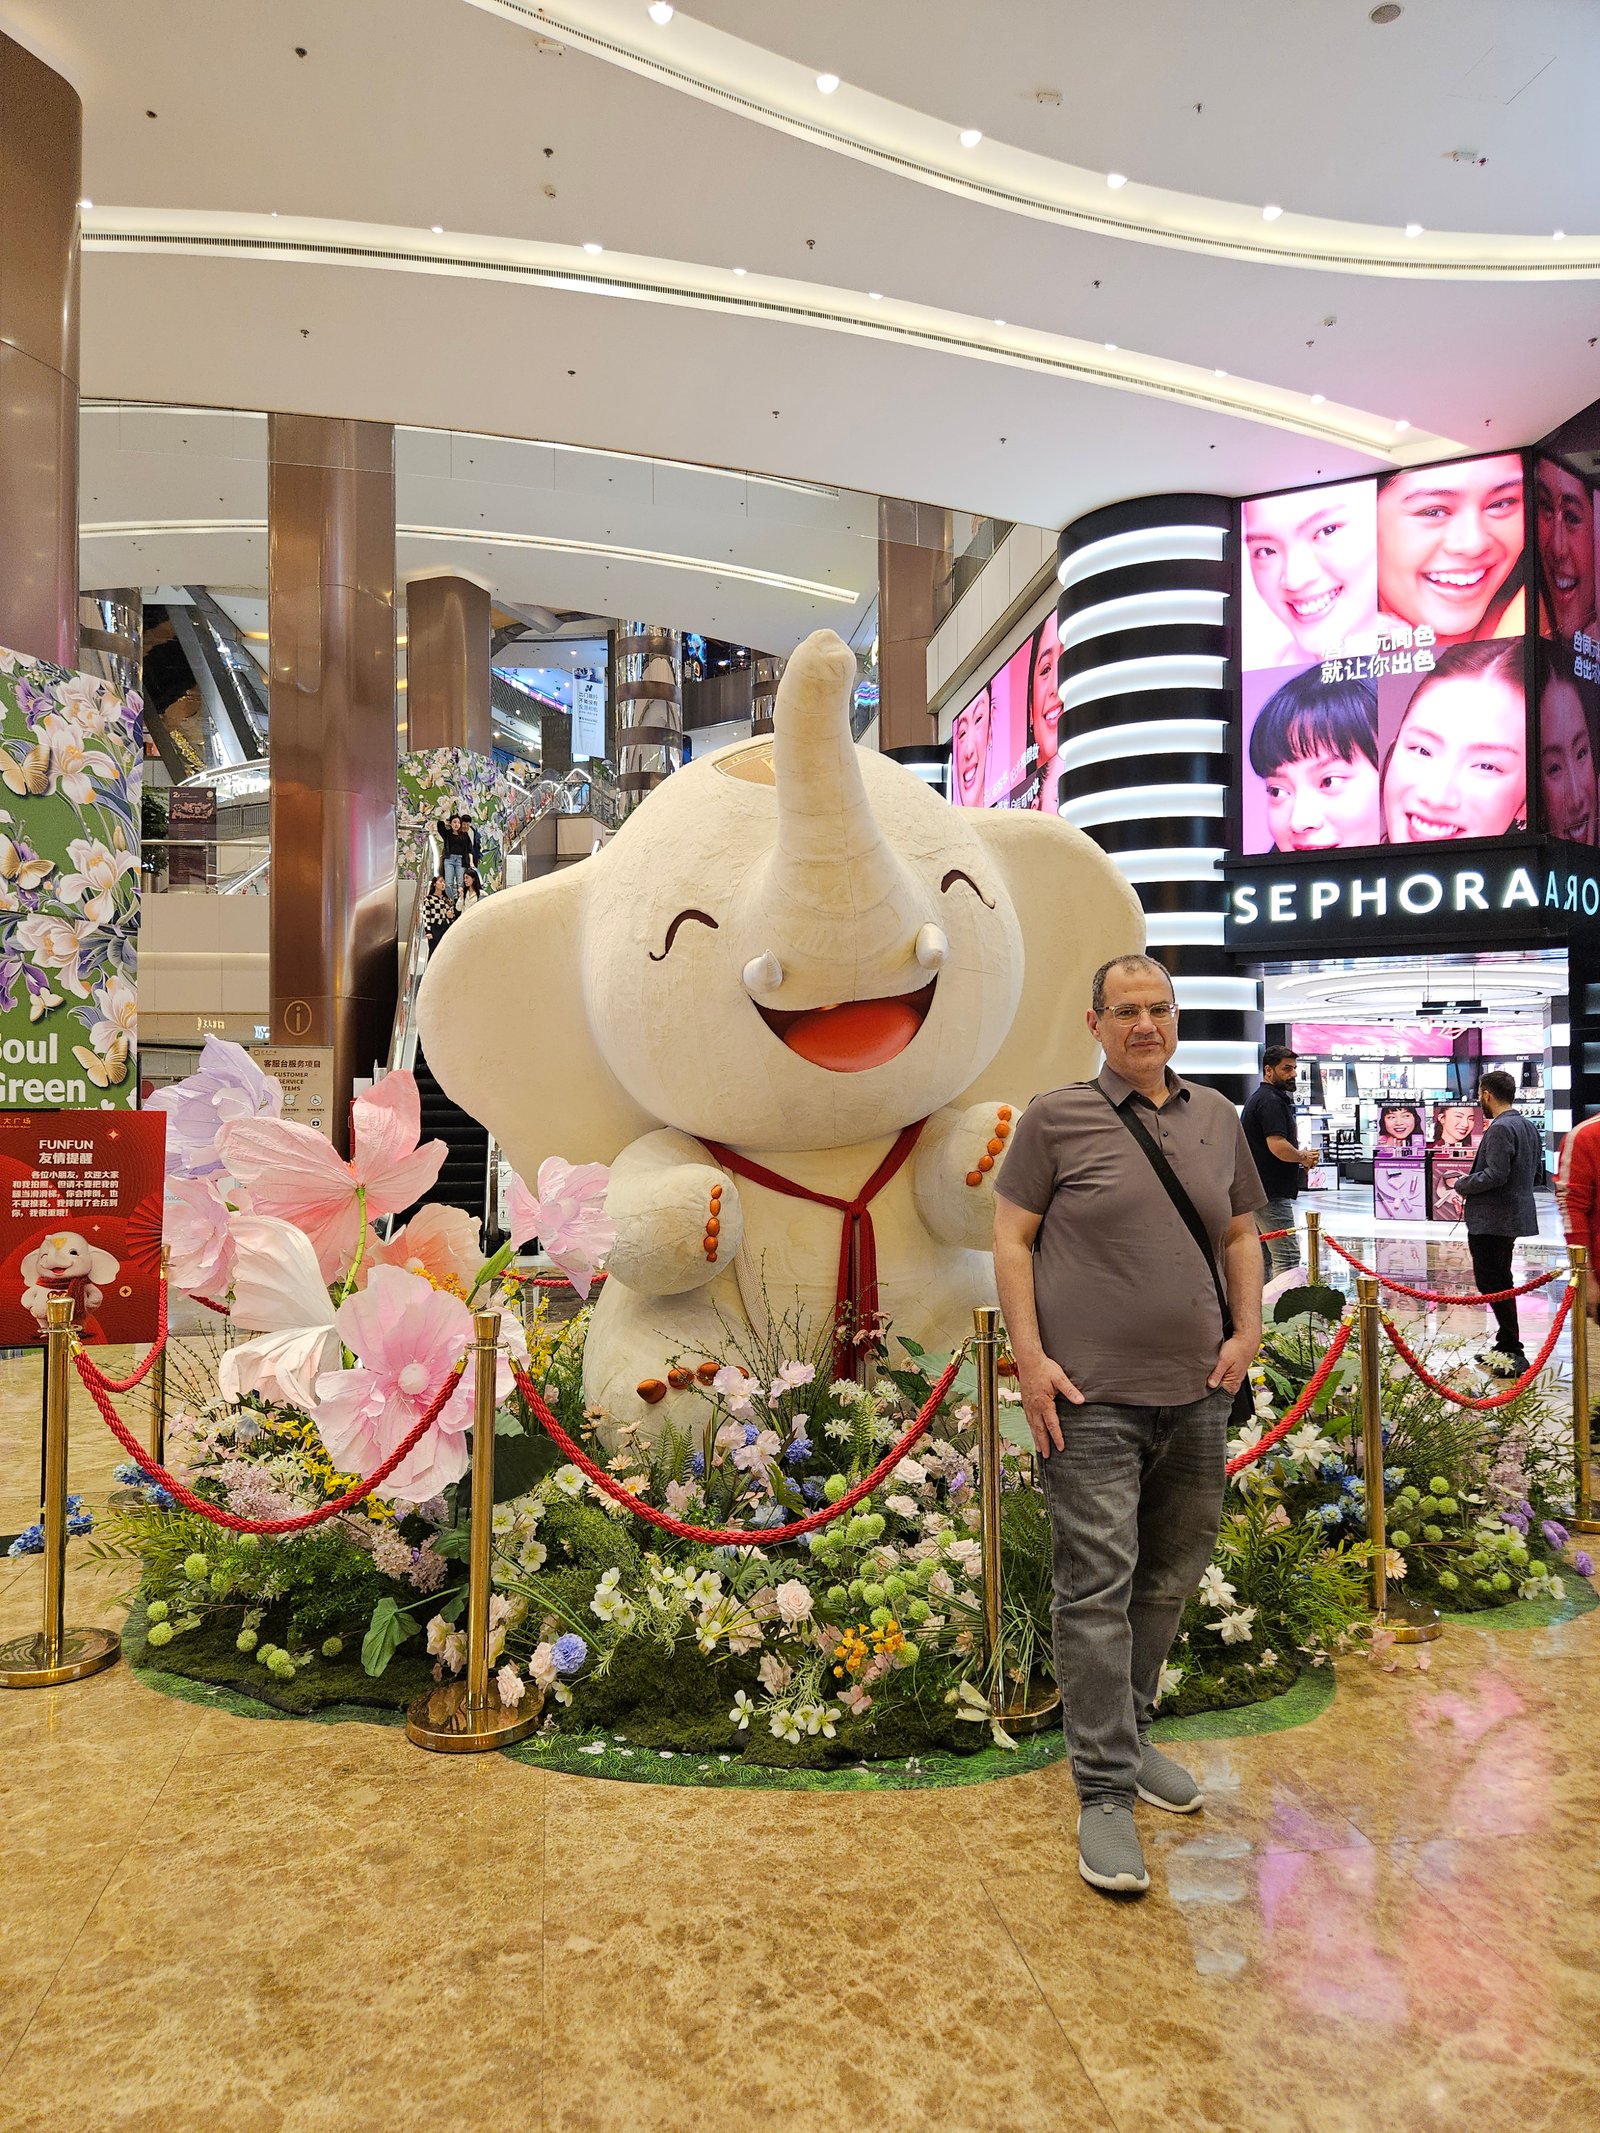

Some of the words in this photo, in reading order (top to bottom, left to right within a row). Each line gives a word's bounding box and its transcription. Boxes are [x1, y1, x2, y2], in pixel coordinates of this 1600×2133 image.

[1320, 648, 1436, 684] 就让你出色
[1234, 868, 1540, 924] SEPHORA
[0, 1033, 58, 1064] oul
[264, 1060, 321, 1068] 客服台服务项目
[0, 1072, 86, 1103] reen
[39, 1140, 94, 1150] FUNFUN
[39, 1153, 94, 1164] 友情提醒
